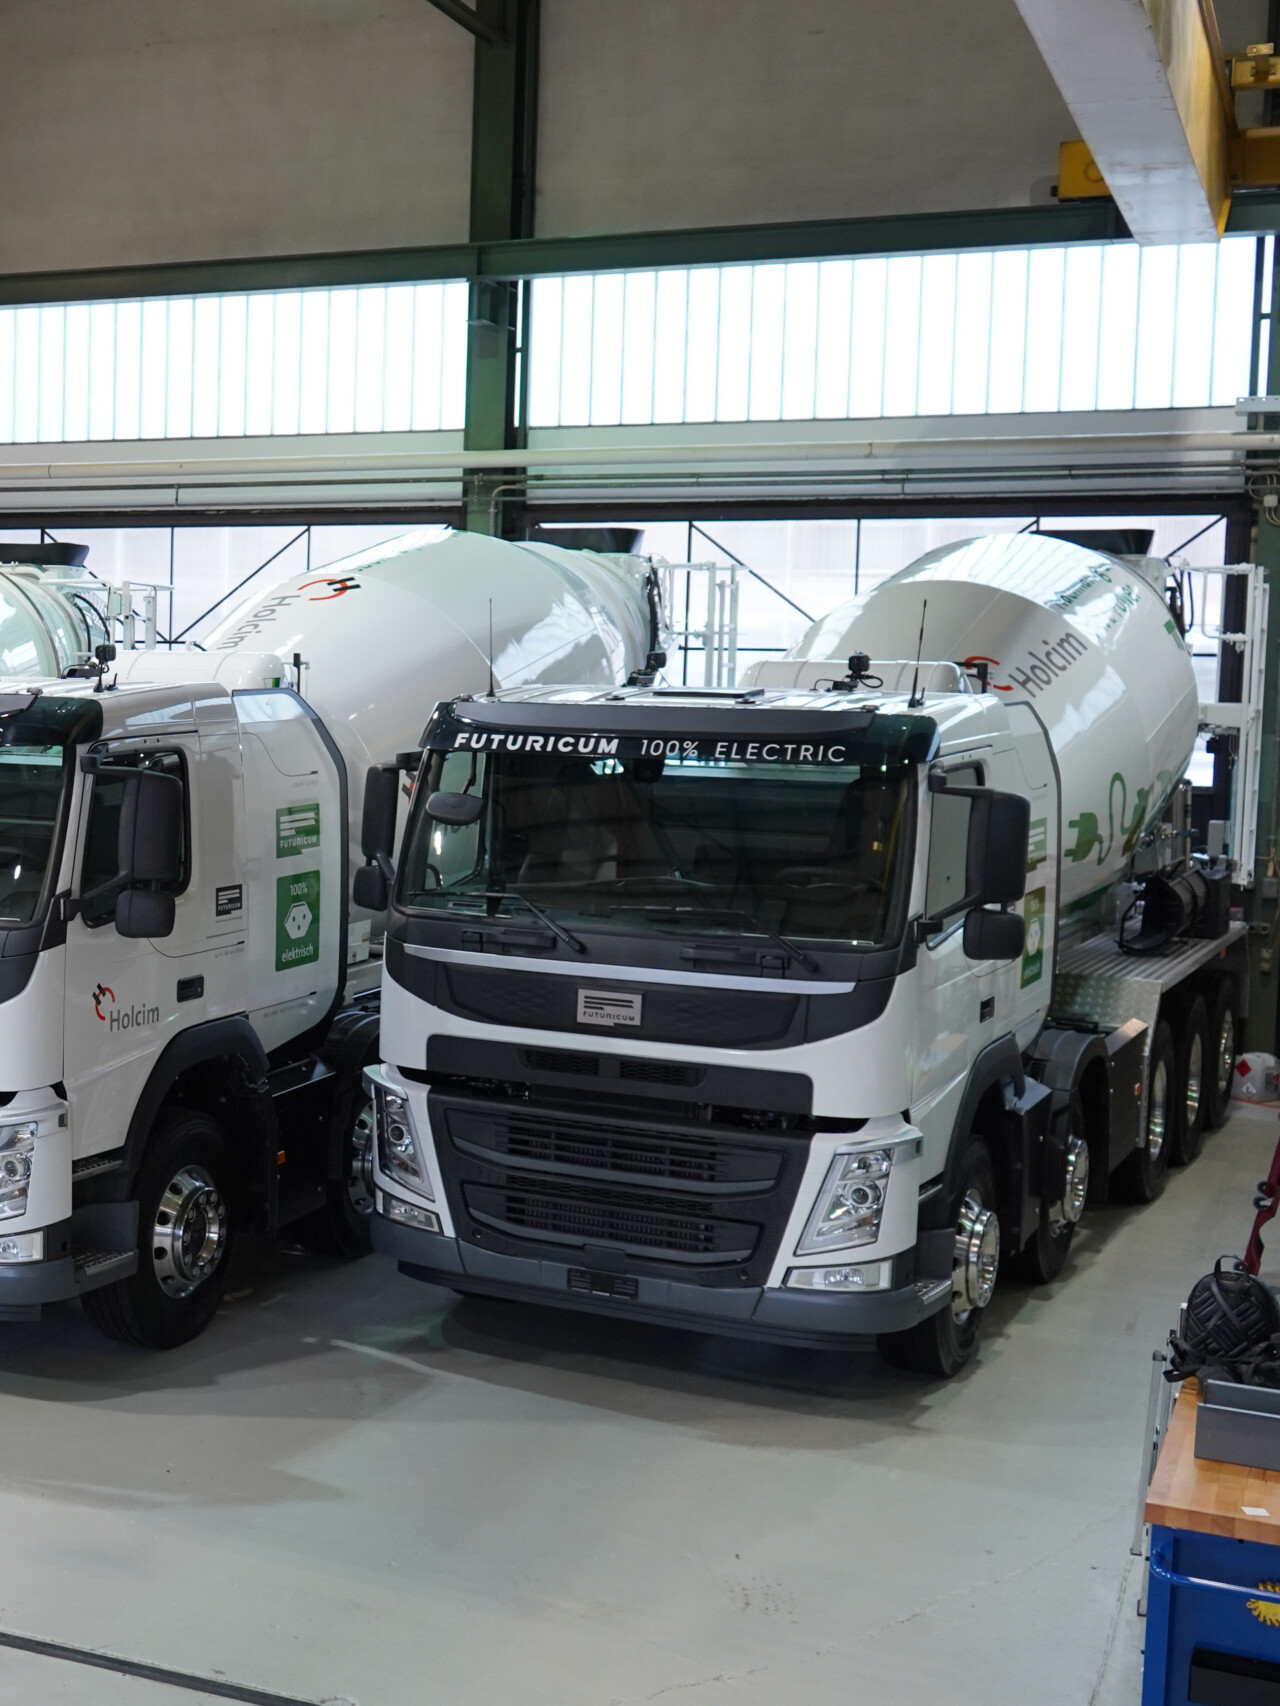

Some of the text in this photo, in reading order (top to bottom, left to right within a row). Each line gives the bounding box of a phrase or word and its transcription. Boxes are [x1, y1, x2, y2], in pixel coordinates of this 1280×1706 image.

[216, 595, 301, 650] Holcim
[1008, 632, 1089, 698] Holcim
[454, 732, 847, 763] FUTURICUM 100% ELECTRIC
[280, 835, 317, 848] FUTURICUM
[290, 882, 308, 897] 100%
[281, 943, 314, 963] elektrisch
[109, 1003, 159, 1032] Holcim
[583, 1010, 635, 1022] FUTURICUM
